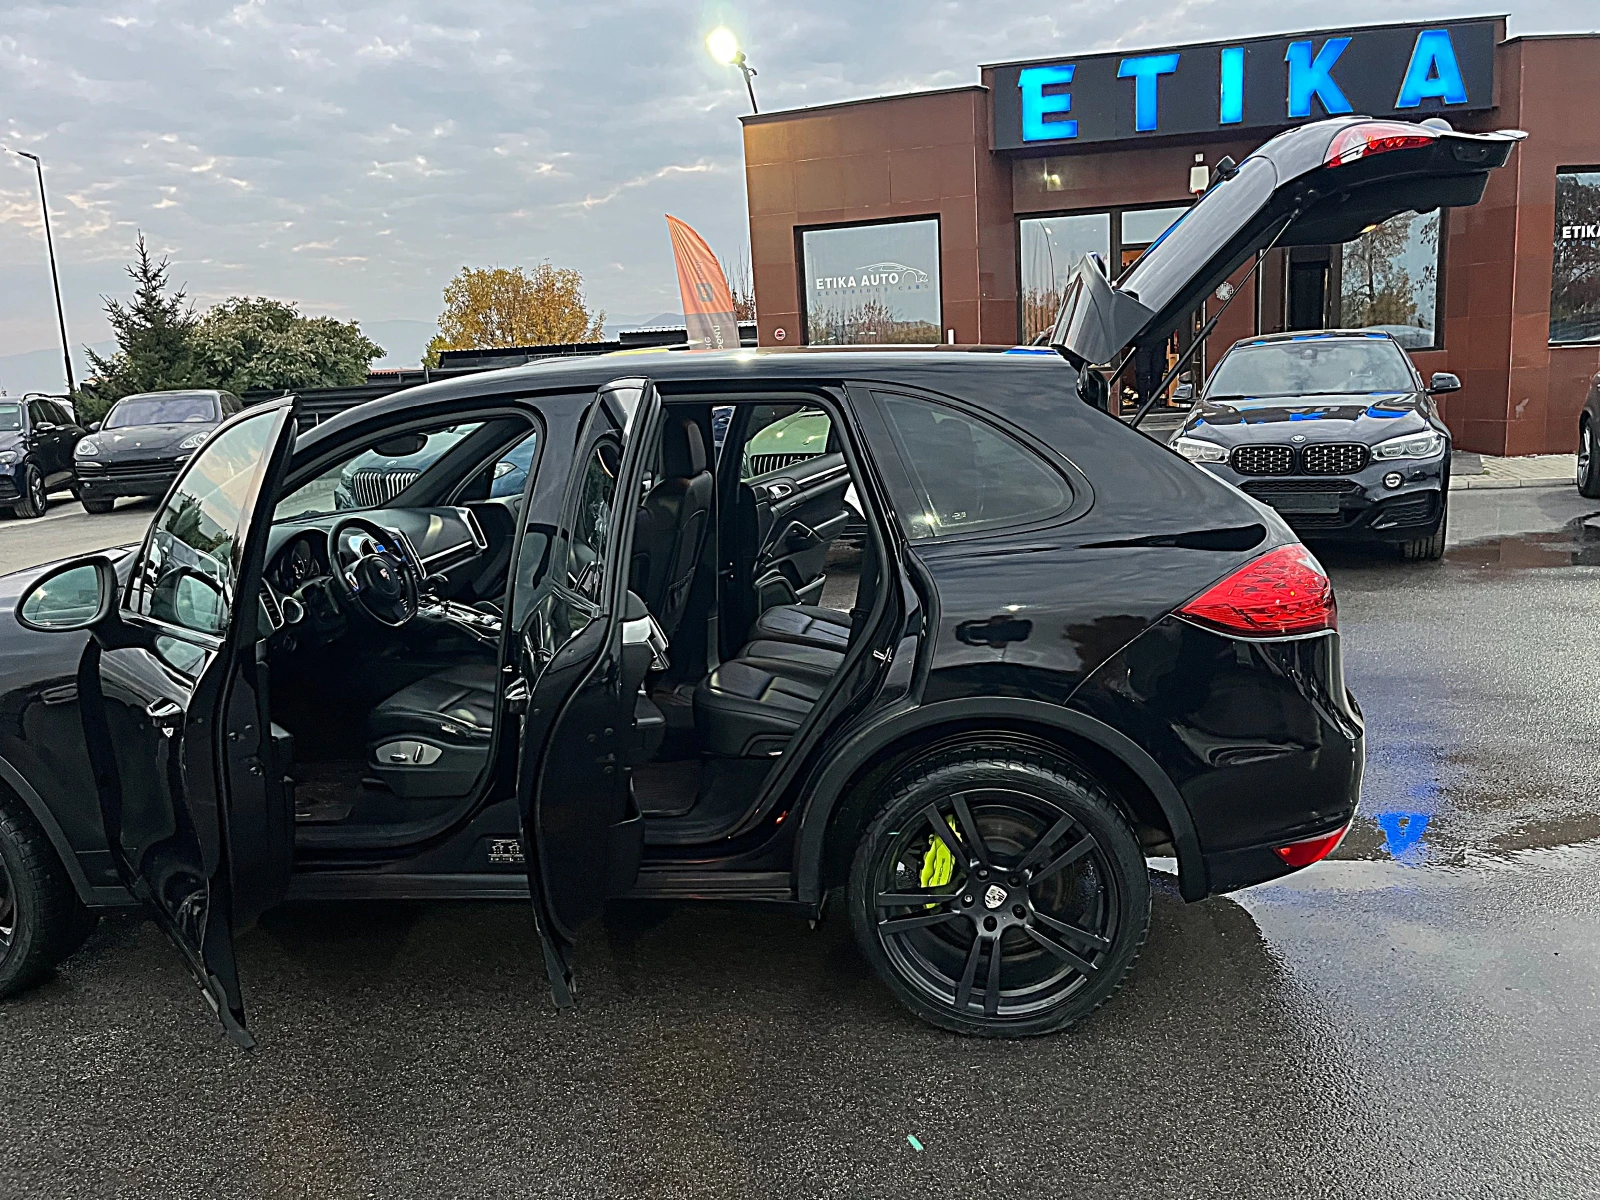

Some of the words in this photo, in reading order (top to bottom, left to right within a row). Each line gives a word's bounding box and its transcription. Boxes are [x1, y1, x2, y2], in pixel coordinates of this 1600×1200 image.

[1018, 29, 1468, 142] ETIKA
[816, 276, 857, 290] ETIKA
[861, 273, 899, 287] AUTO
